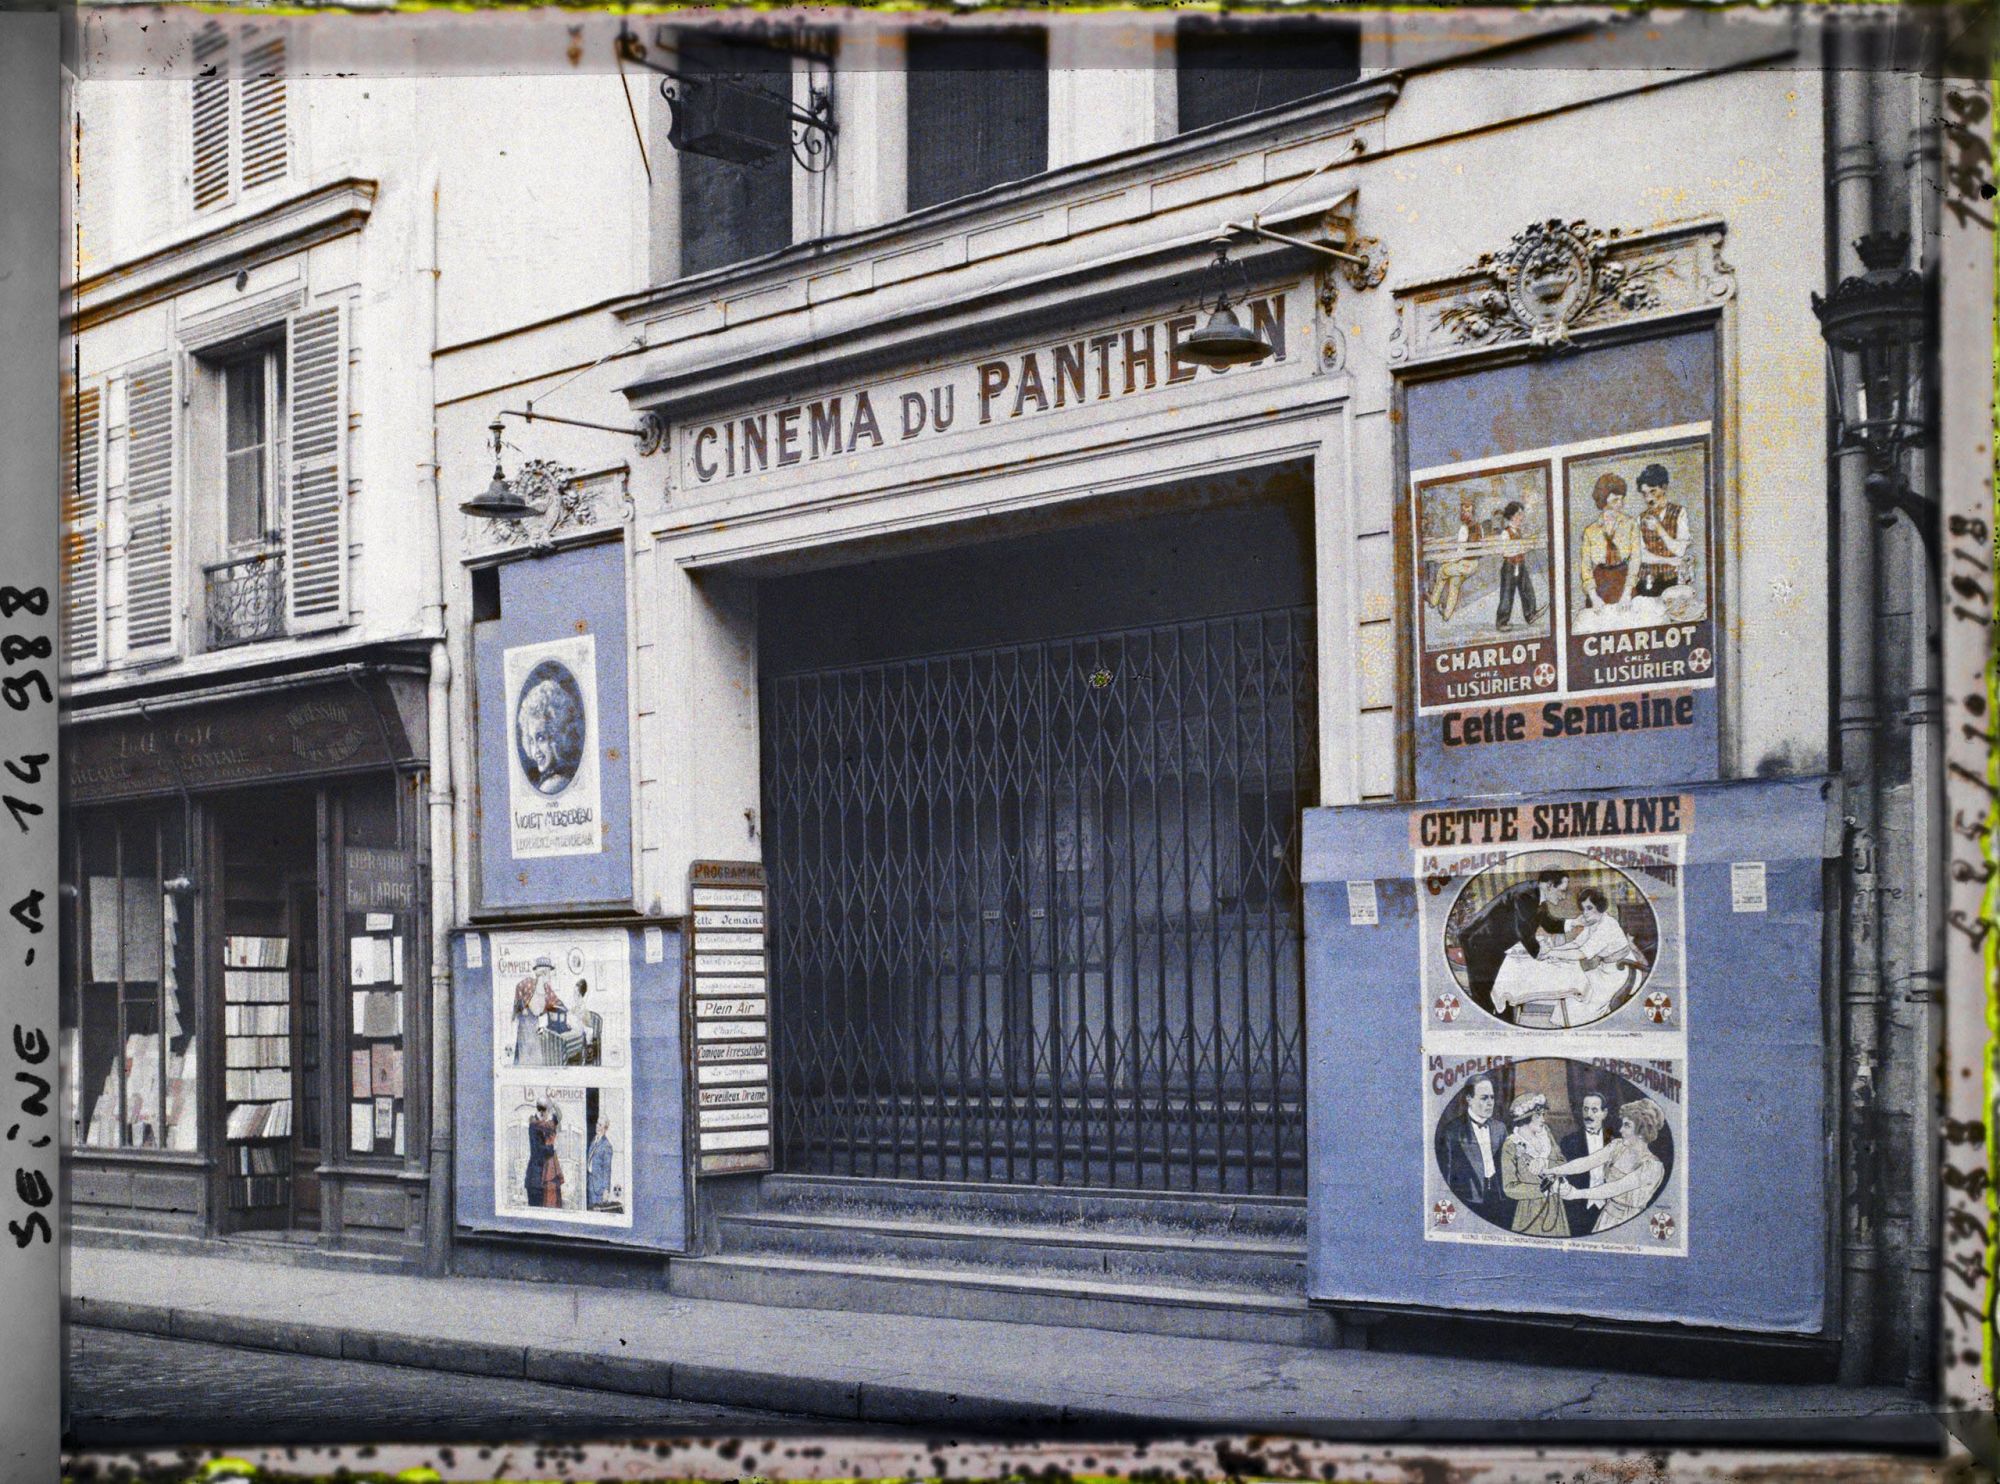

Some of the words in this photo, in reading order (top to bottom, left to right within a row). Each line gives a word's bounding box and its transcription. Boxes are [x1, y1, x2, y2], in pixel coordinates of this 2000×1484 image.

[692, 390, 884, 482] CINEMA
[900, 383, 955, 440] DU
[976, 295, 1287, 424] PANTHEN
[0, 583, 54, 712] 988
[1583, 626, 1697, 657] CHARLOT
[1435, 643, 1541, 674] CHARLOT
[1624, 653, 1651, 664] CHEZ
[1473, 670, 1499, 679] CHEZ
[1594, 660, 1686, 685] LUSURIER
[1446, 675, 1533, 700] LUSURIER
[1442, 708, 1526, 747] Cette
[1541, 693, 1694, 738] Semaine
[1, 750, 51, 835] 14
[1420, 806, 1519, 847] CETTE
[1532, 796, 1681, 840] SEMAINE
[1644, 844, 1670, 857] THE
[693, 862, 764, 879] PROGRAMME
[1423, 856, 1439, 873] LA
[1426, 850, 1507, 896] COMPLICE
[499, 946, 511, 957] LA
[498, 957, 532, 974] COMPLICE
[704, 1002, 733, 1015] Plein
[735, 1001, 755, 1014] Air
[1429, 1055, 1444, 1072] LA
[1649, 1060, 1673, 1074] THE
[1431, 1055, 1513, 1096] COMPLICE
[523, 1085, 535, 1102] LA
[545, 1087, 584, 1100] COMPLICE
